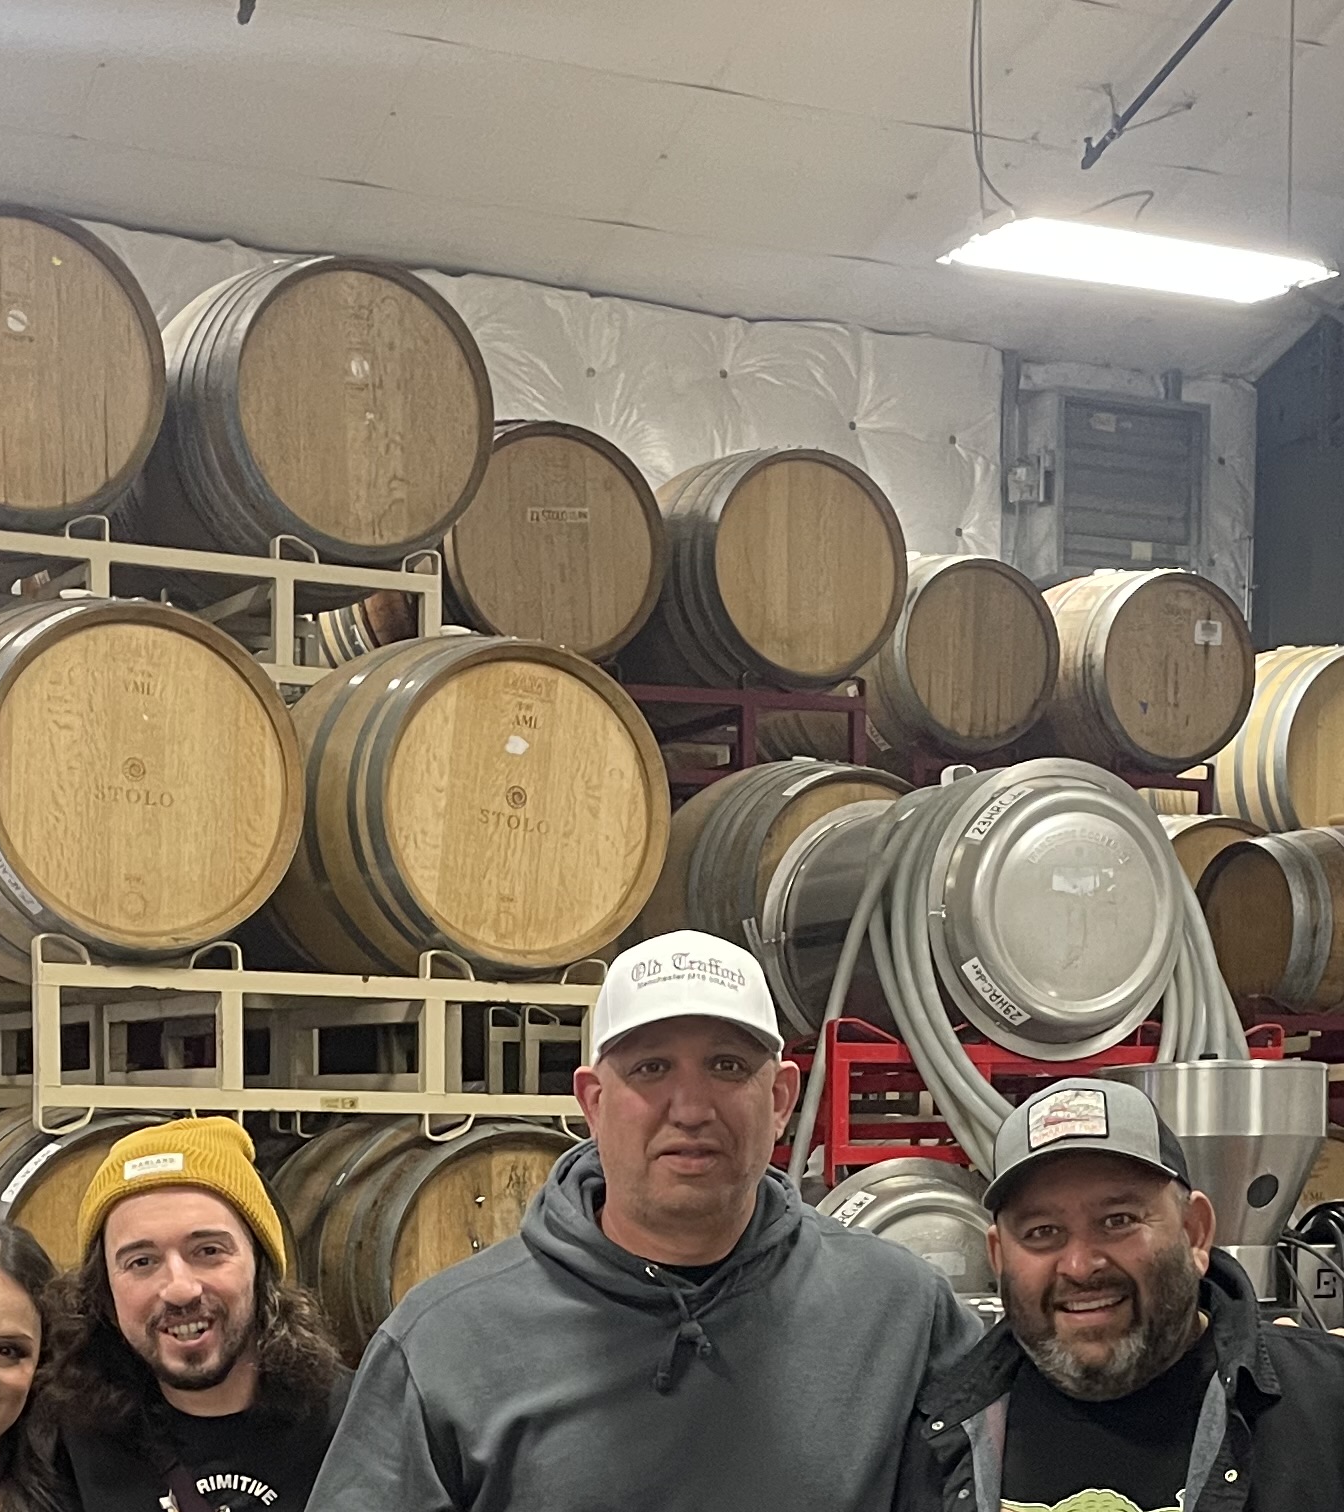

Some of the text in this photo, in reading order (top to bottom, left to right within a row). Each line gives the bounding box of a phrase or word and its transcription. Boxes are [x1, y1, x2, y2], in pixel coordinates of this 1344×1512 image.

[94, 785, 175, 809] STOLO
[478, 808, 551, 837] STOLO
[631, 952, 746, 986] Old Trafford
[196, 1474, 278, 1506] RIMITIVE
